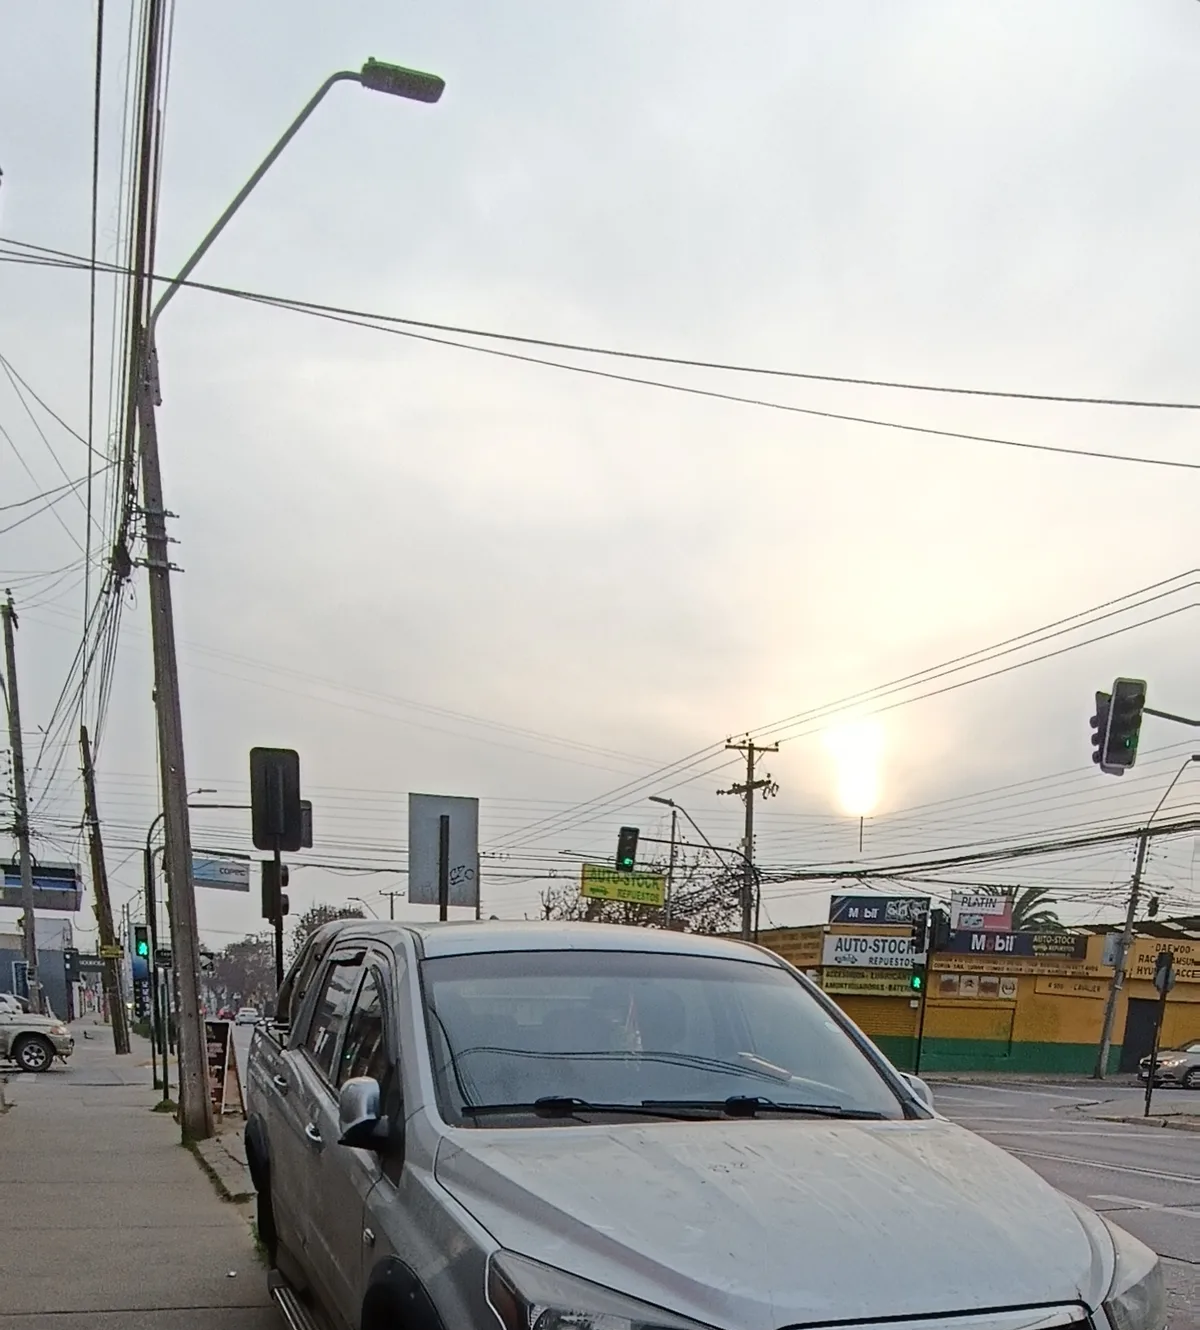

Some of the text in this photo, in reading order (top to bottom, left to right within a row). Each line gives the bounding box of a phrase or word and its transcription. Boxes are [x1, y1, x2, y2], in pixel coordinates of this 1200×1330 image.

[617, 888, 660, 903] REPUESTOS
[961, 896, 997, 908] PLATIN
[1033, 935, 1075, 945] AUTO-STOCK
[869, 956, 915, 967] REPUESTOS
